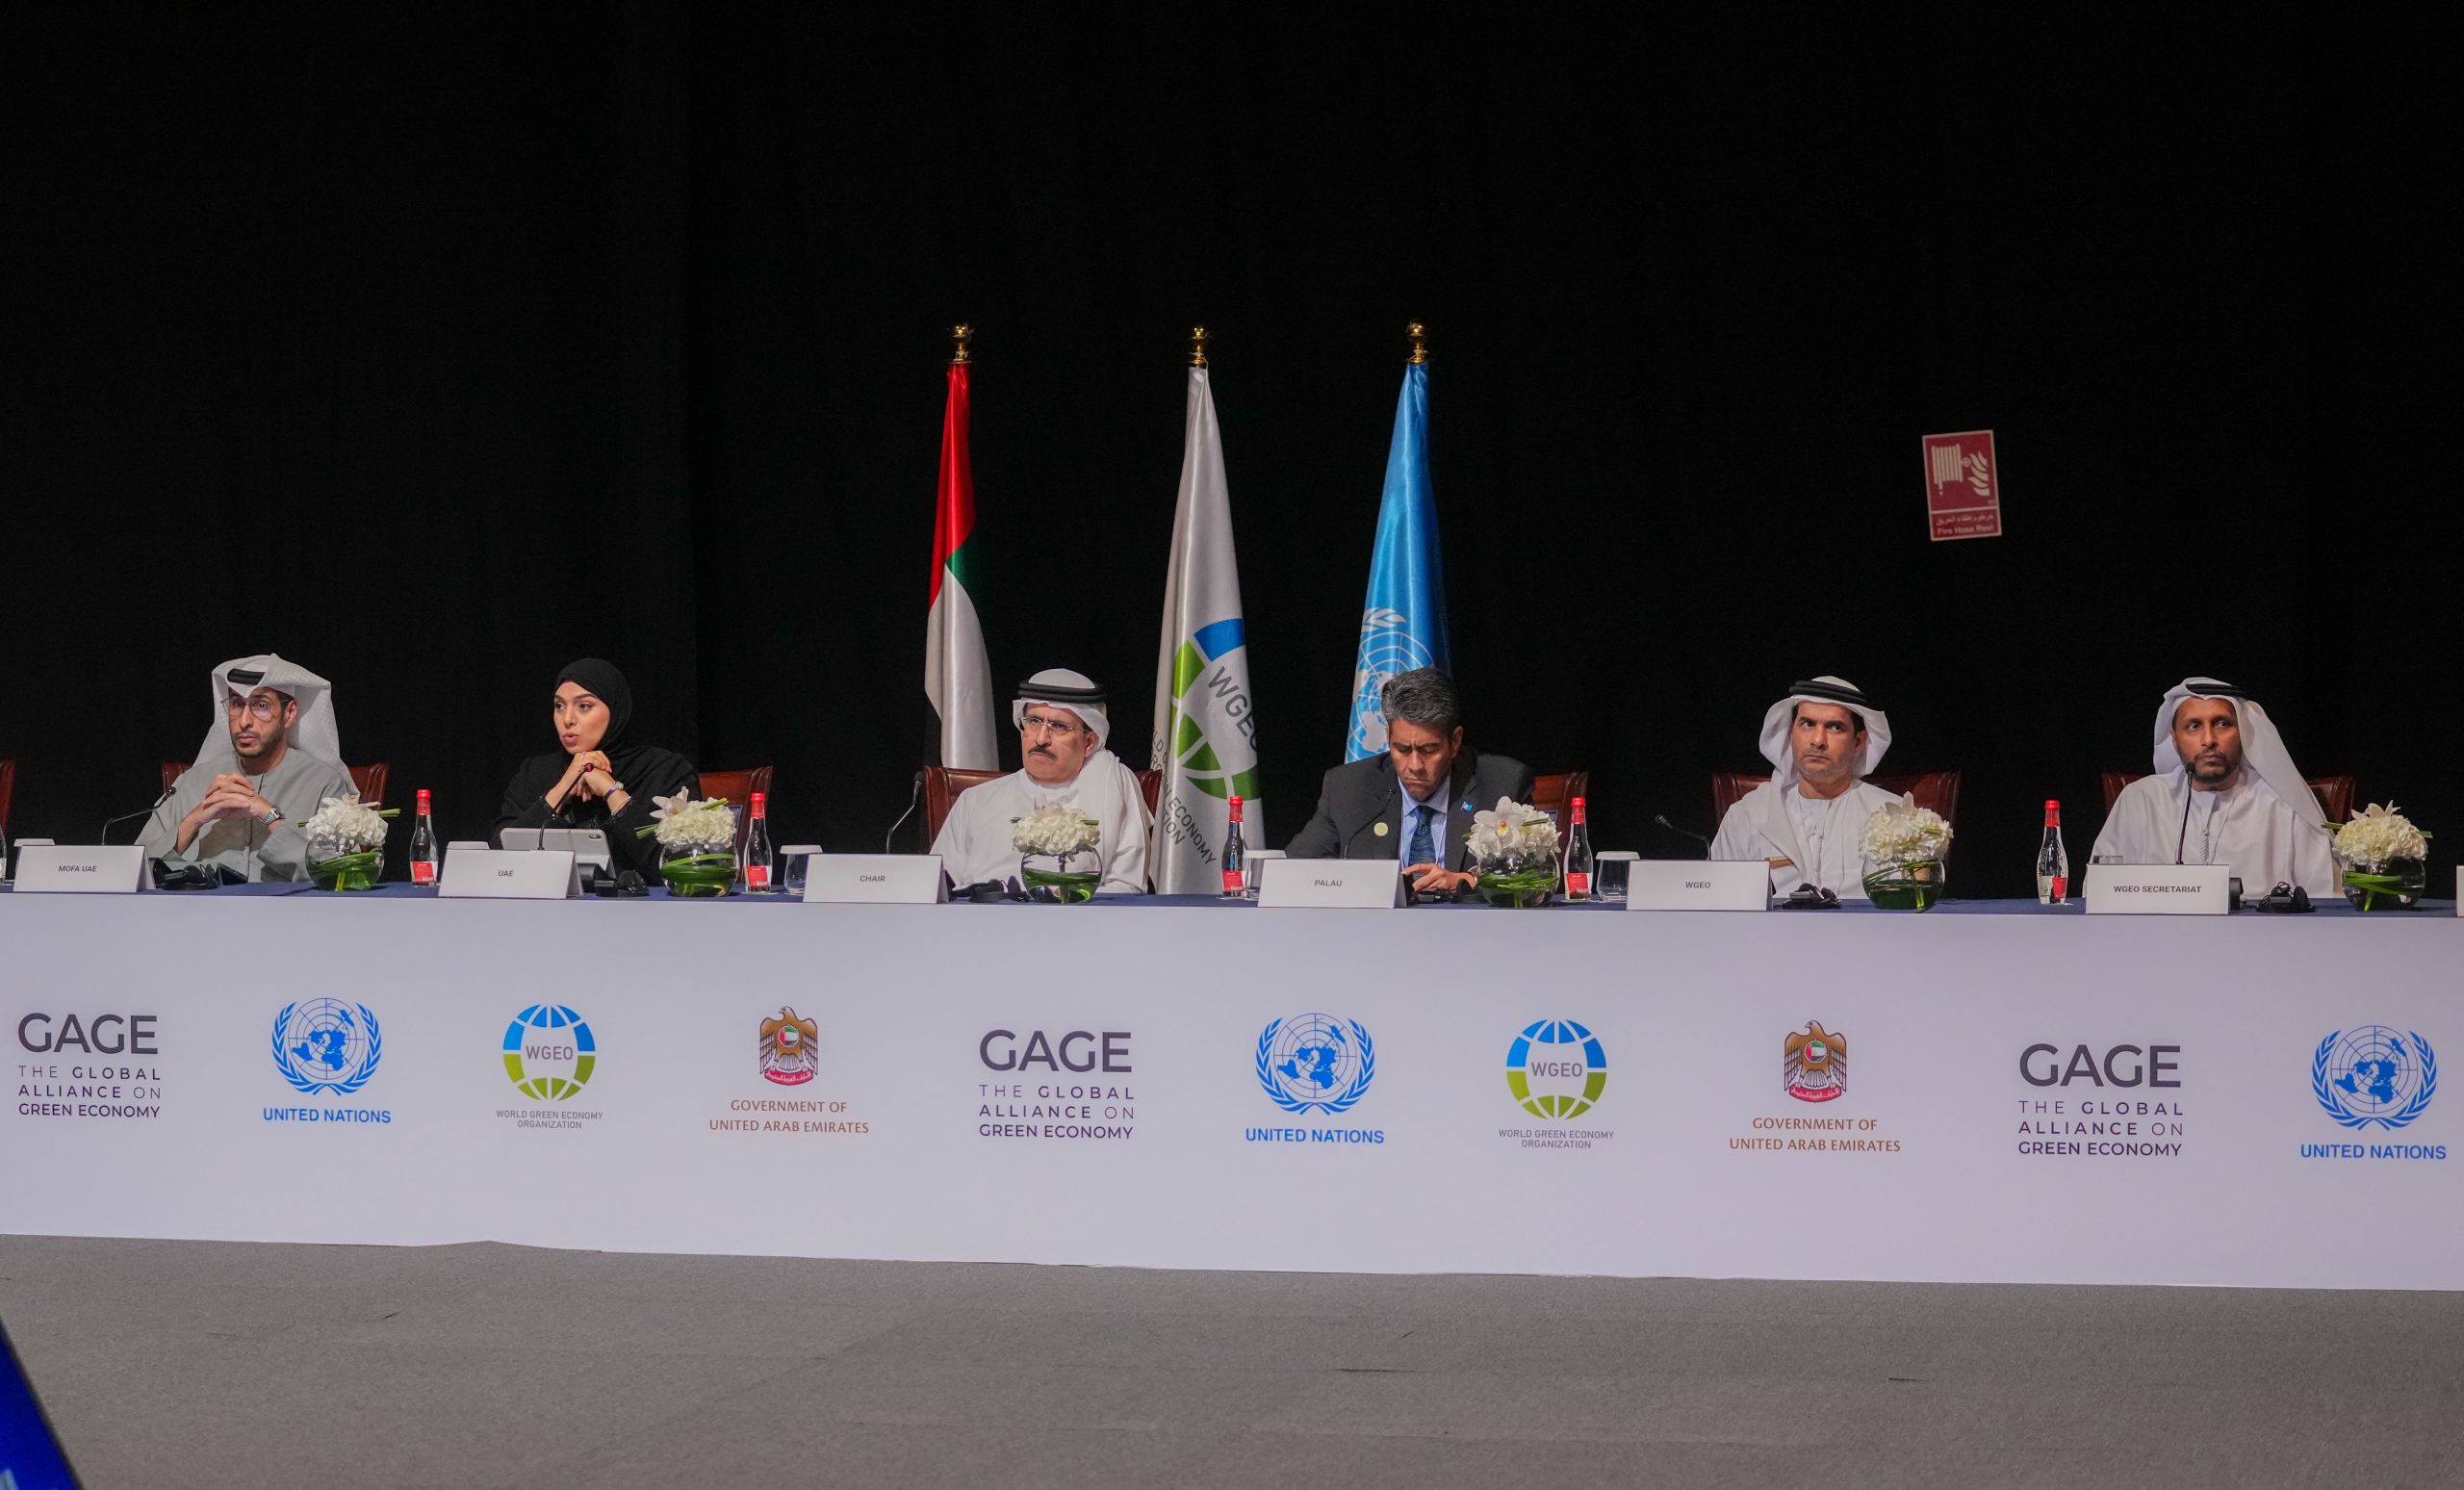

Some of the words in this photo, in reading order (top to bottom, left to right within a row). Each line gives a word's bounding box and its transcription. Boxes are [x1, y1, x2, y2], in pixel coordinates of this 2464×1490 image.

[1168, 796, 1217, 865] ECONOMY
[860, 874, 886, 883] CHAIR
[1314, 879, 1343, 887] PALAU
[1685, 881, 1711, 889] WGEO
[2114, 885, 2141, 893] WGEO
[2142, 885, 2202, 893] SECRETARIAT
[17, 1012, 159, 1055] GAGE
[525, 1045, 574, 1061] WGEO
[979, 1029, 1133, 1073] GAGE
[17, 1065, 58, 1079] THE
[71, 1066, 161, 1081] GLOBAL
[1530, 1062, 1583, 1078] WGEO
[2019, 1042, 2182, 1089] GAGE
[17, 1084, 121, 1099] ALLIANCE
[133, 1086, 161, 1100] ON
[978, 1084, 1022, 1098] THE
[1038, 1085, 1135, 1100] GLOBAL
[18, 1102, 72, 1117] GREEN
[78, 1104, 161, 1118] ECONOMY
[496, 1109, 527, 1118] WORLD
[529, 1110, 559, 1119] GREEN
[561, 1111, 603, 1120] ECONOMY
[731, 1099, 826, 1113] GOVERNMENT
[829, 1101, 847, 1114] OF
[979, 1104, 1091, 1119] ALLIANCE
[1104, 1106, 1134, 1120] ON
[2017, 1100, 2065, 1115] THE
[2081, 1101, 2184, 1117] GLOBAL
[263, 1108, 320, 1122] UNITED
[323, 1109, 392, 1124] NATIONS
[517, 1119, 582, 1129] ORGANIZATION
[1752, 1117, 1855, 1131] GOVERNMENT
[1858, 1118, 1878, 1131] OF
[709, 1118, 759, 1132] UNITED
[762, 1120, 800, 1132] ARAB
[804, 1120, 869, 1134] EMIRATES
[979, 1123, 1038, 1138] GREEN
[1044, 1124, 1134, 1140] ECONOMY
[2017, 1120, 2138, 1136] ALLIANCE
[2151, 1122, 2183, 1137] ON
[1245, 1127, 1307, 1143] UNITED
[1311, 1128, 1385, 1144] NATIONS
[1498, 1129, 1532, 1139] WORLD
[1534, 1129, 1567, 1139] GREEN
[1569, 1129, 1614, 1140] ECONOMY
[1521, 1139, 1592, 1149] ORGANIZATION
[1730, 1138, 1784, 1150] UNITED
[1786, 1139, 1827, 1151] ARAB
[1831, 1139, 1901, 1152] EMIRATES
[2017, 1141, 2081, 1155] GREEN
[2088, 1142, 2182, 1157] ECONOMY
[2300, 1143, 2365, 1159] UNITED
[2370, 1144, 2447, 1160] NATIONS
